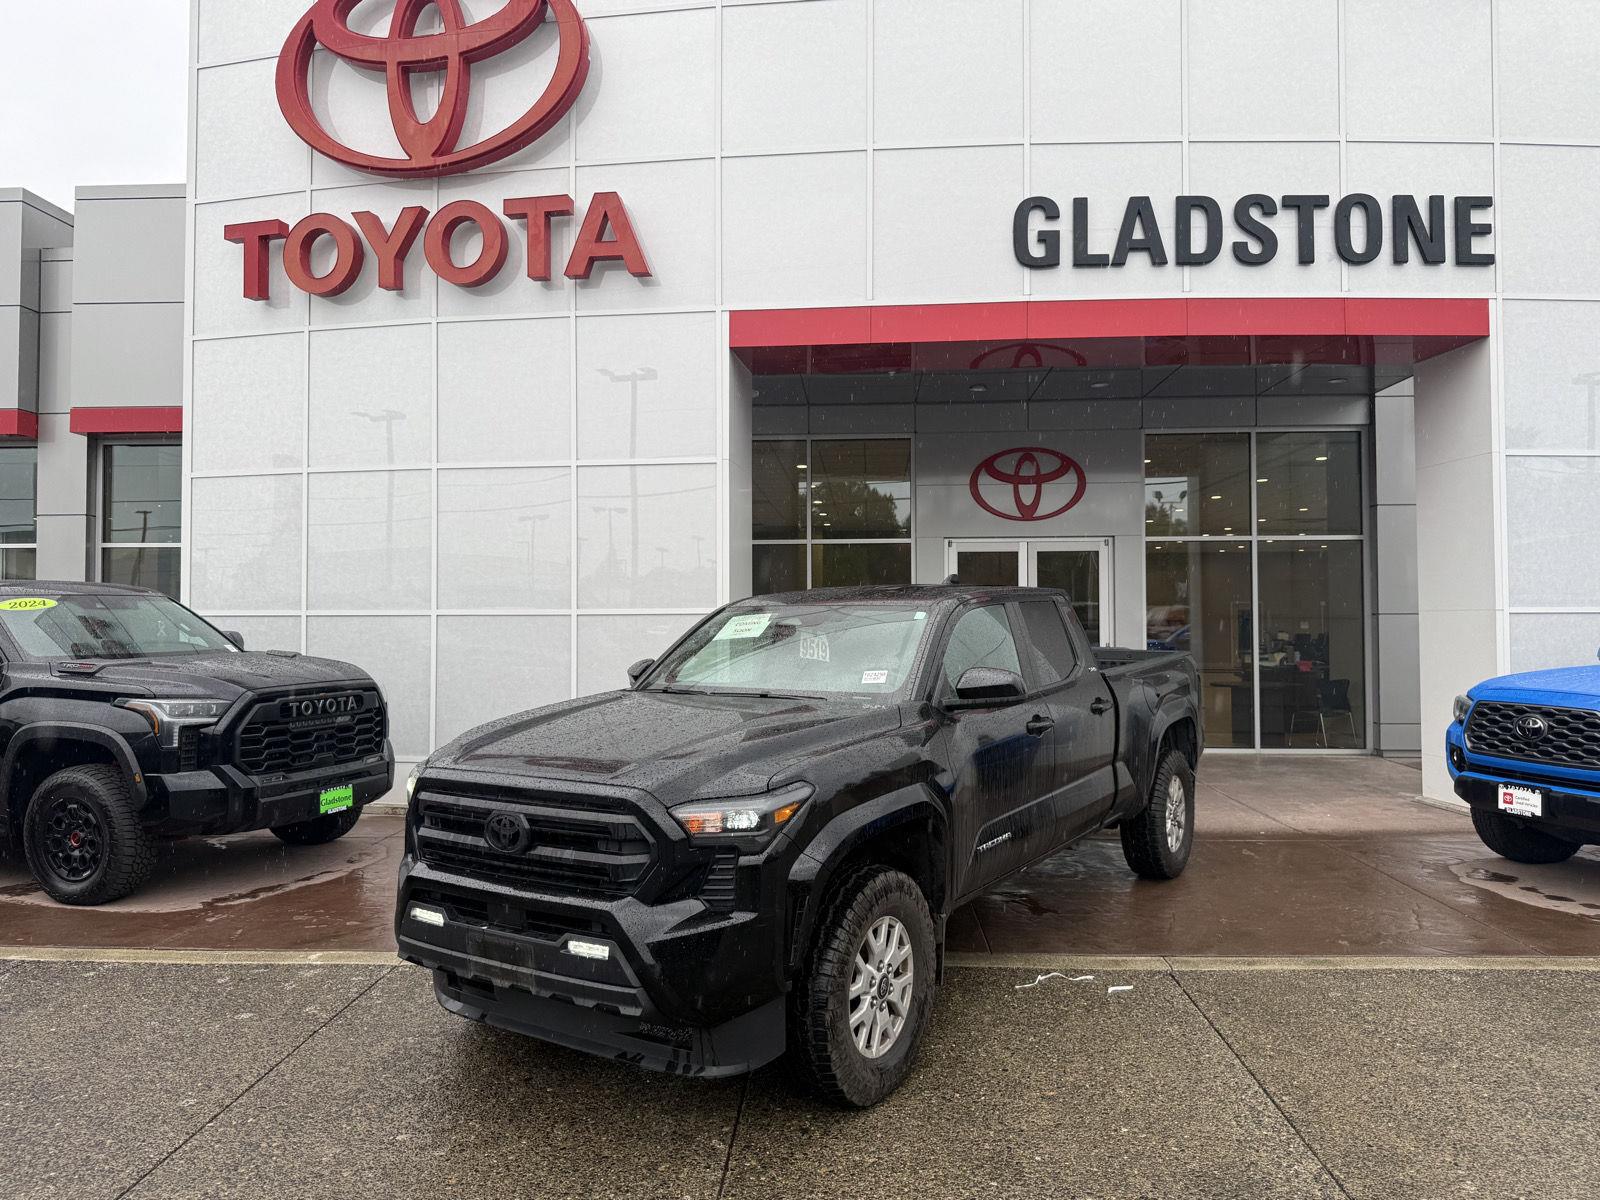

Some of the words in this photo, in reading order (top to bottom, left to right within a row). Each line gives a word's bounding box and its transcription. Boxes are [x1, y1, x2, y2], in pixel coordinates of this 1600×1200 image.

[1012, 193, 1496, 269] GLADSTONE
[224, 191, 652, 301] TOYOTA
[8, 600, 47, 609] 2024
[289, 696, 357, 718] TOYOTA
[320, 794, 352, 806] Gladstone
